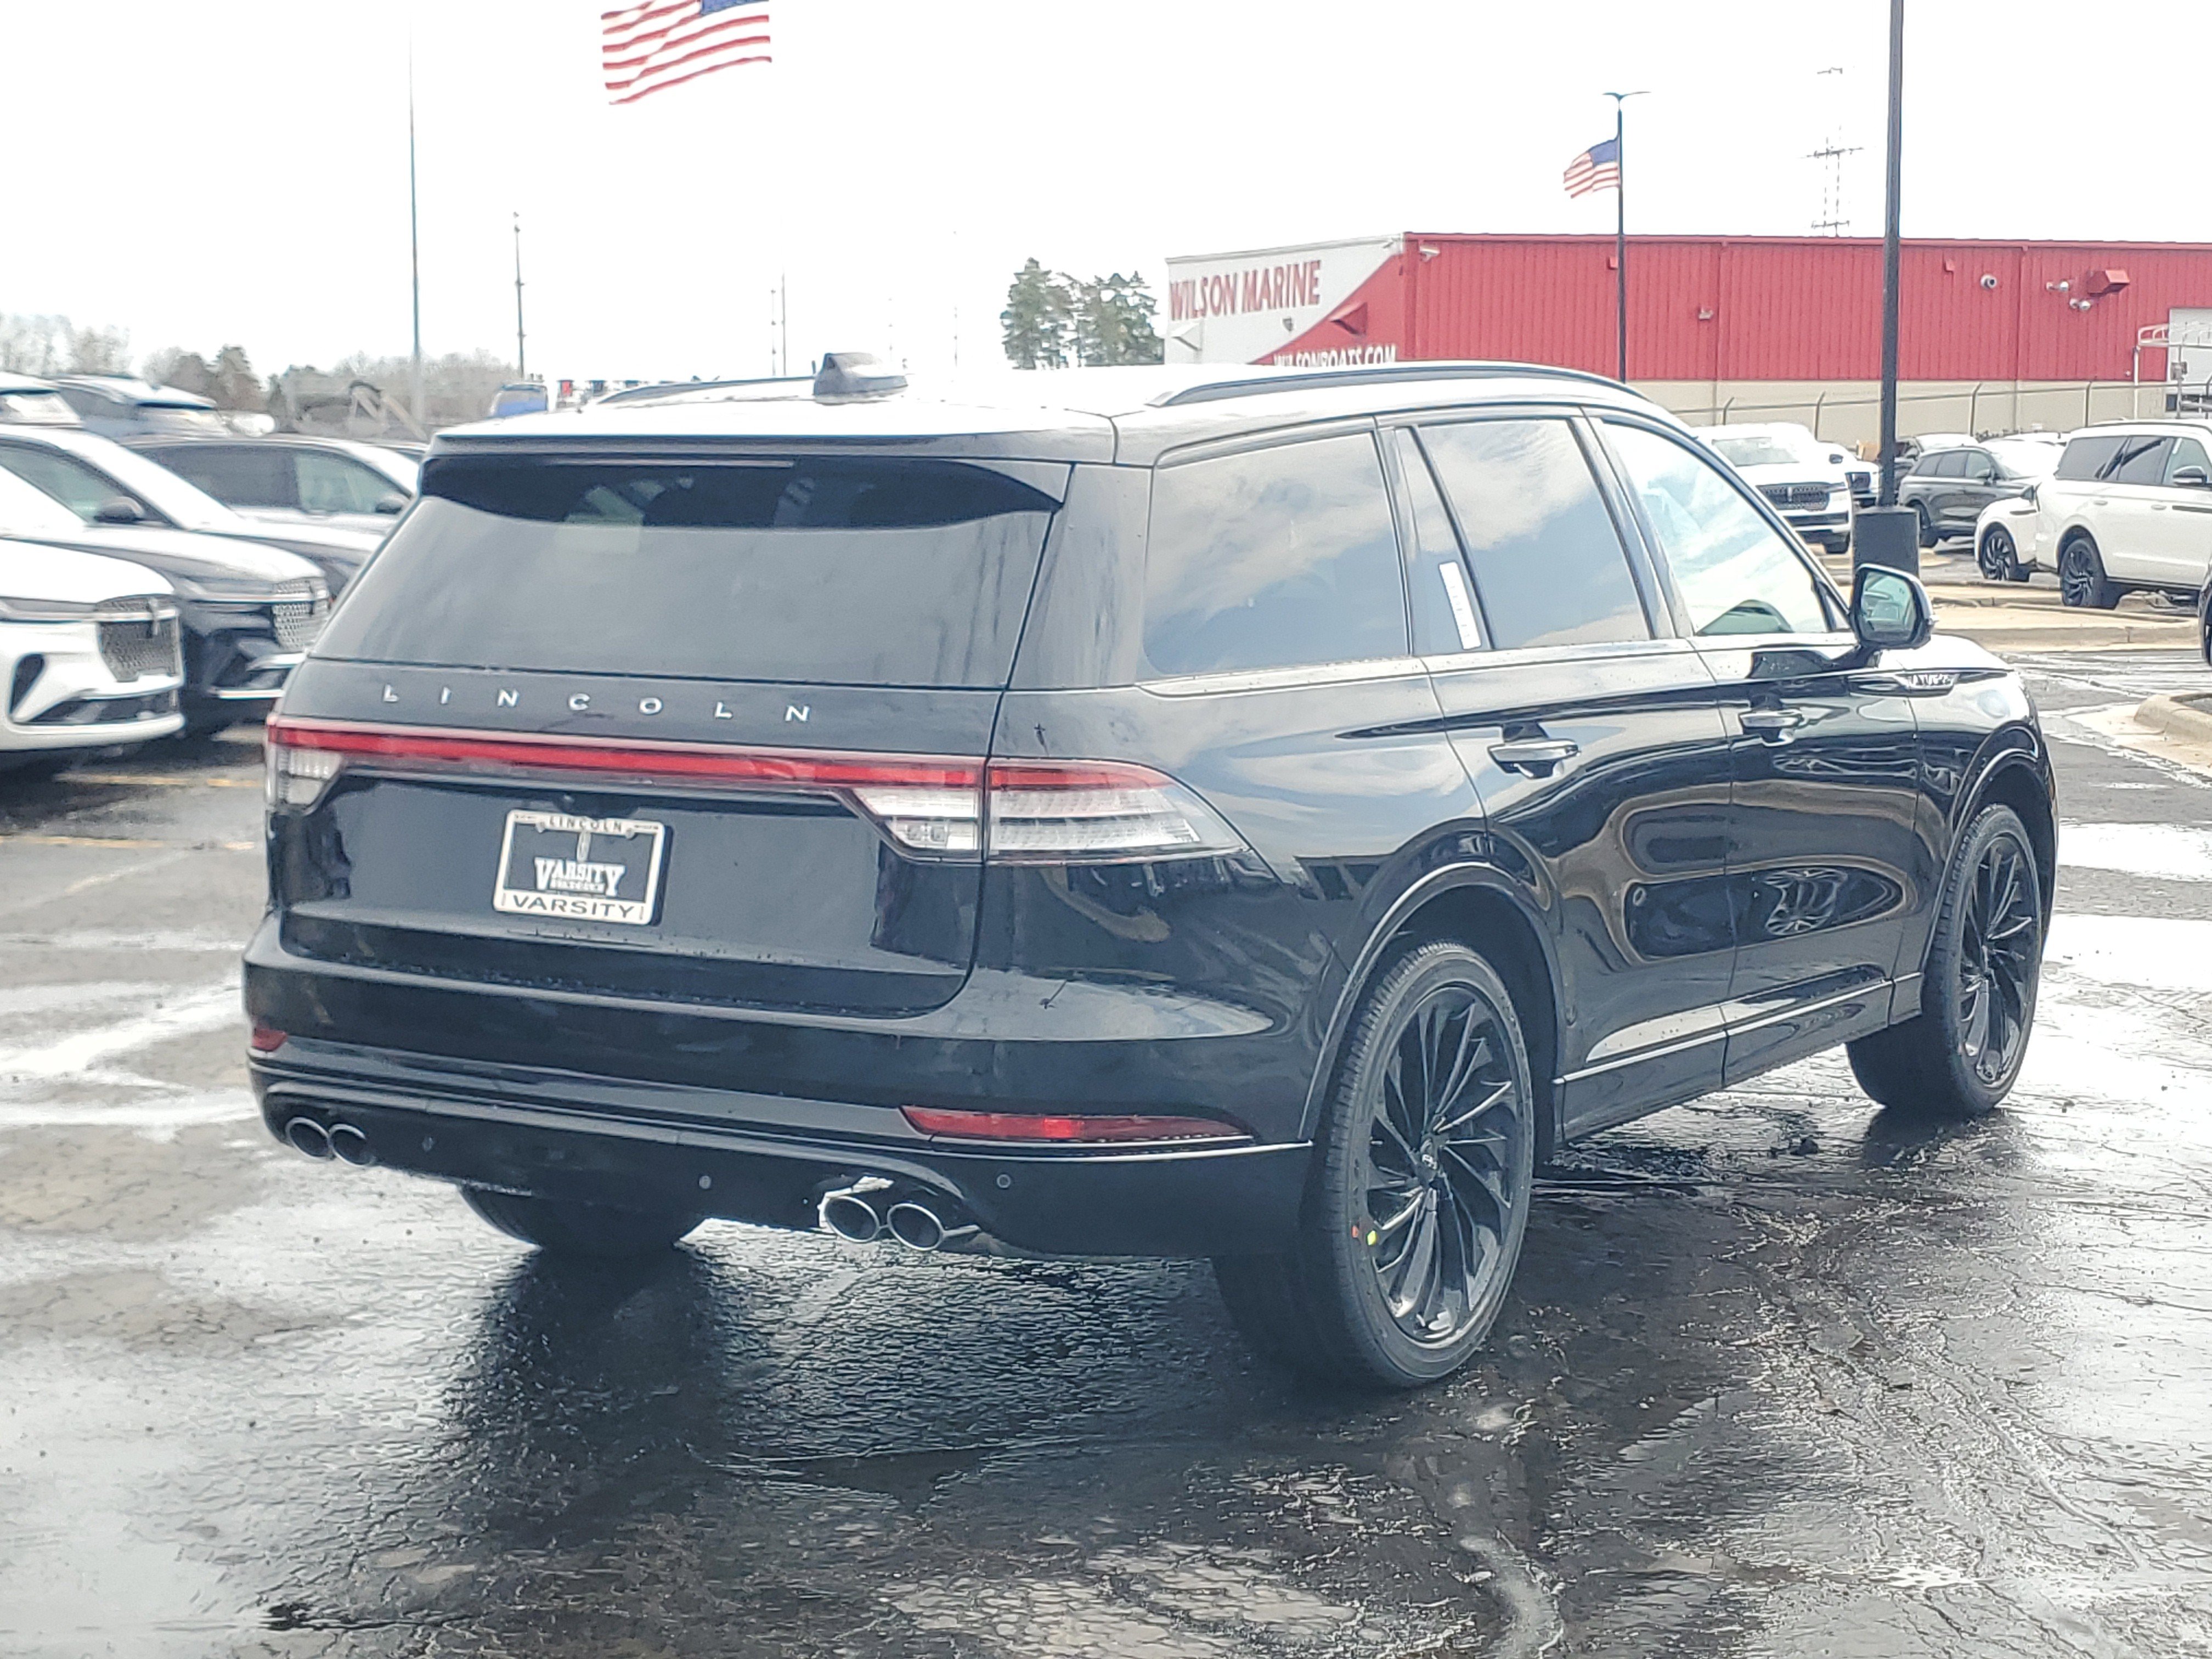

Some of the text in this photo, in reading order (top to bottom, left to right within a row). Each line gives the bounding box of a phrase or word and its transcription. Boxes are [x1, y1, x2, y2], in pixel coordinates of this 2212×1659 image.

[1170, 259, 1322, 321] WILSON MARINE
[382, 684, 812, 723] LINCOLN
[549, 816, 623, 832] LINCOLN
[534, 856, 625, 897] VARSITY
[513, 894, 635, 918] VARSITY
